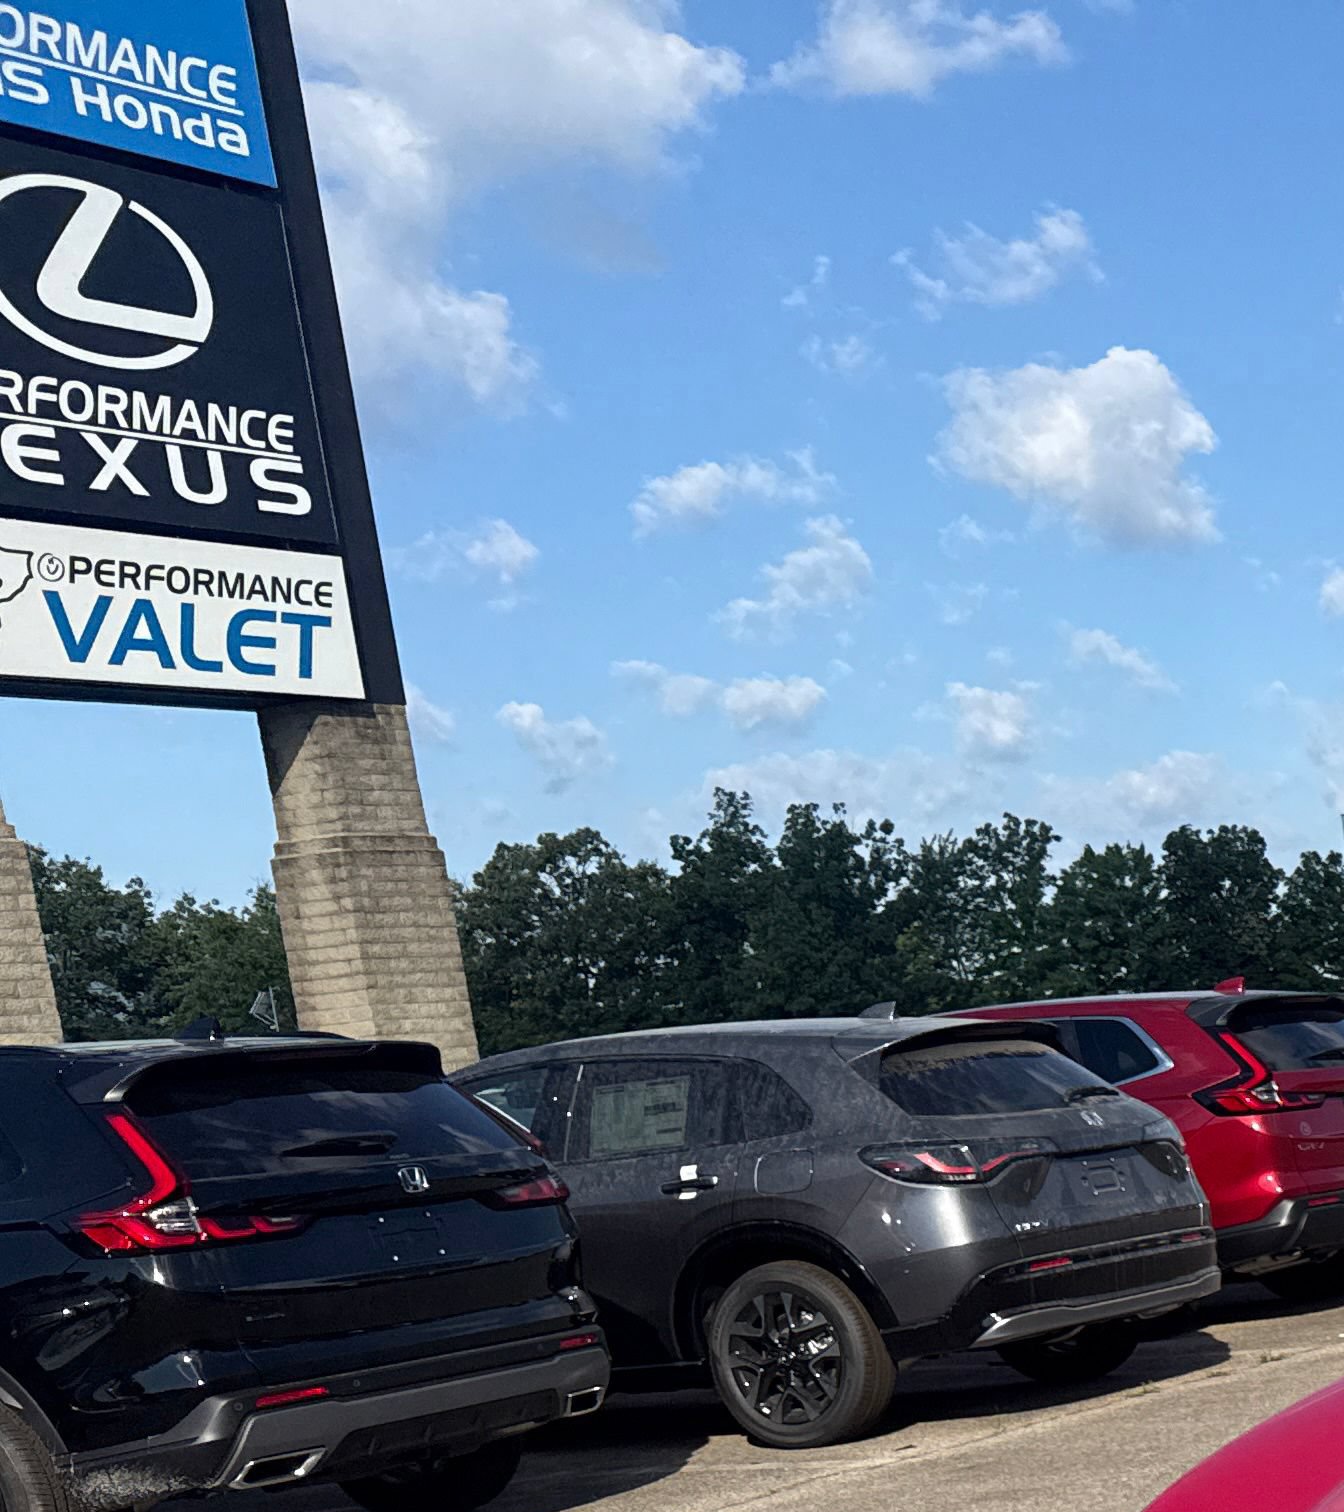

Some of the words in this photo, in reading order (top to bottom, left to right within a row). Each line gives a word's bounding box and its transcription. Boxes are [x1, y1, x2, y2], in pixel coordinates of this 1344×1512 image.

[0, 3, 237, 107] ORMANCE
[0, 60, 50, 105] S
[69, 76, 250, 157] Honda
[0, 369, 294, 453] RFORMANCE
[0, 423, 312, 515] EXUS
[69, 555, 333, 609] PERFORMANCE
[42, 589, 333, 680] VALET
